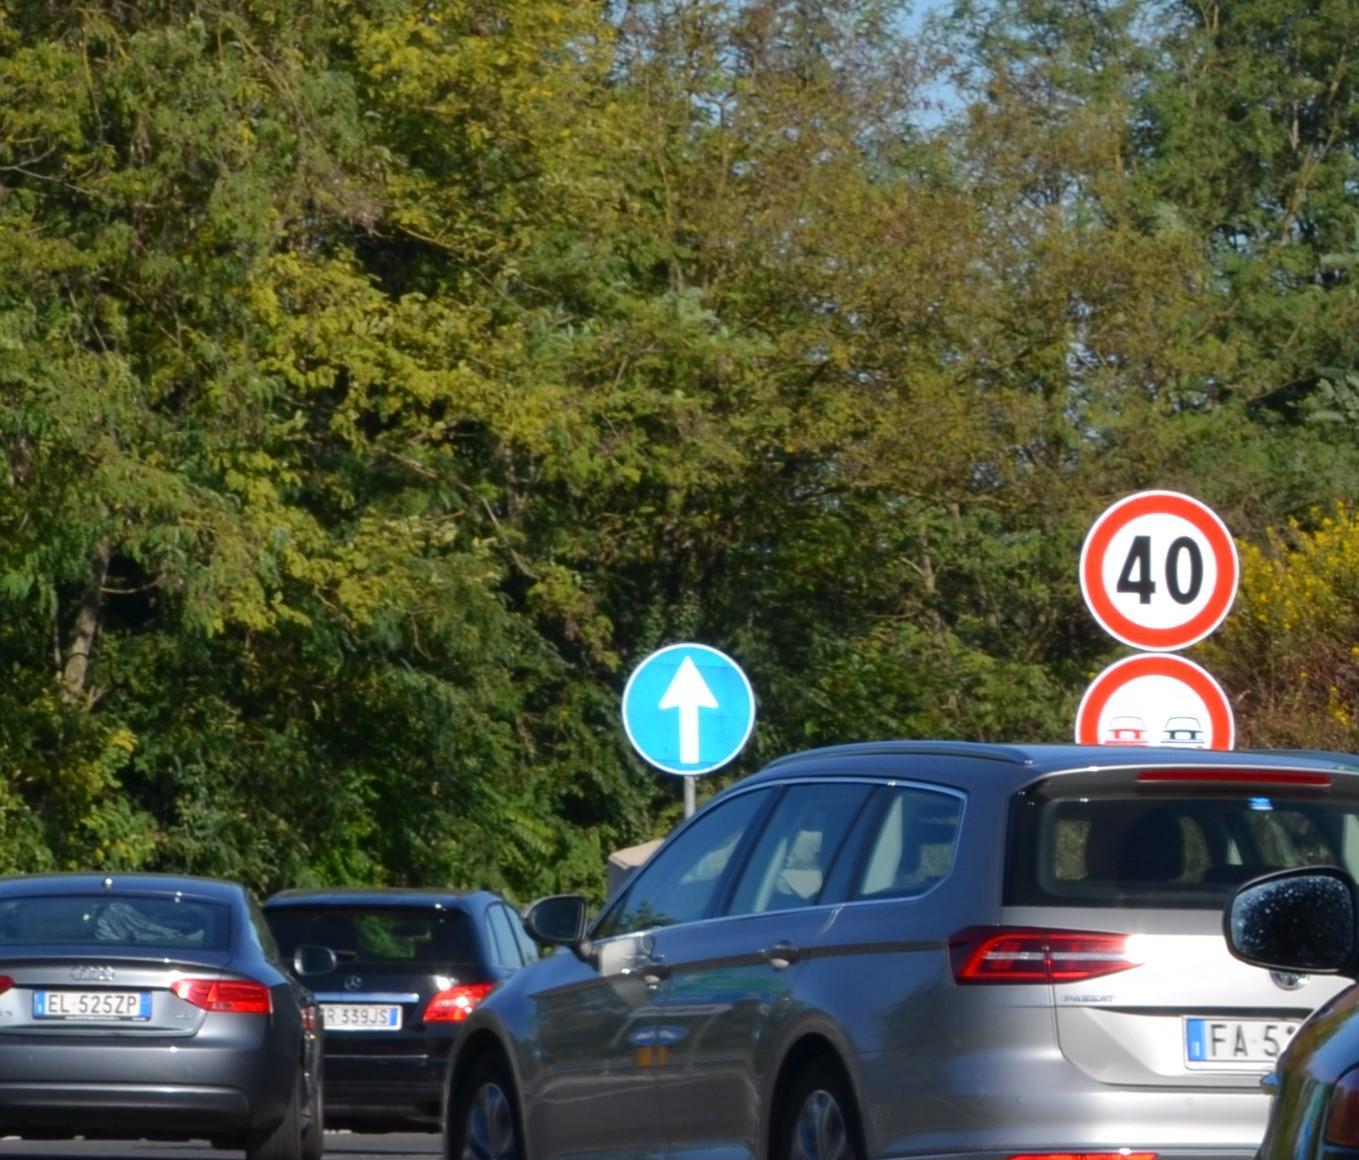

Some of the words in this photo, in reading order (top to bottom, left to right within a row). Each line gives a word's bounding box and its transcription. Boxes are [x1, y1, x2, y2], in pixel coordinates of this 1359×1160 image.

[1116, 536, 1202, 605] 40
[49, 994, 70, 1013] EL
[79, 995, 137, 1014] 525ZP
[1210, 1024, 1249, 1058] FA
[1263, 1025, 1295, 1058] 5
